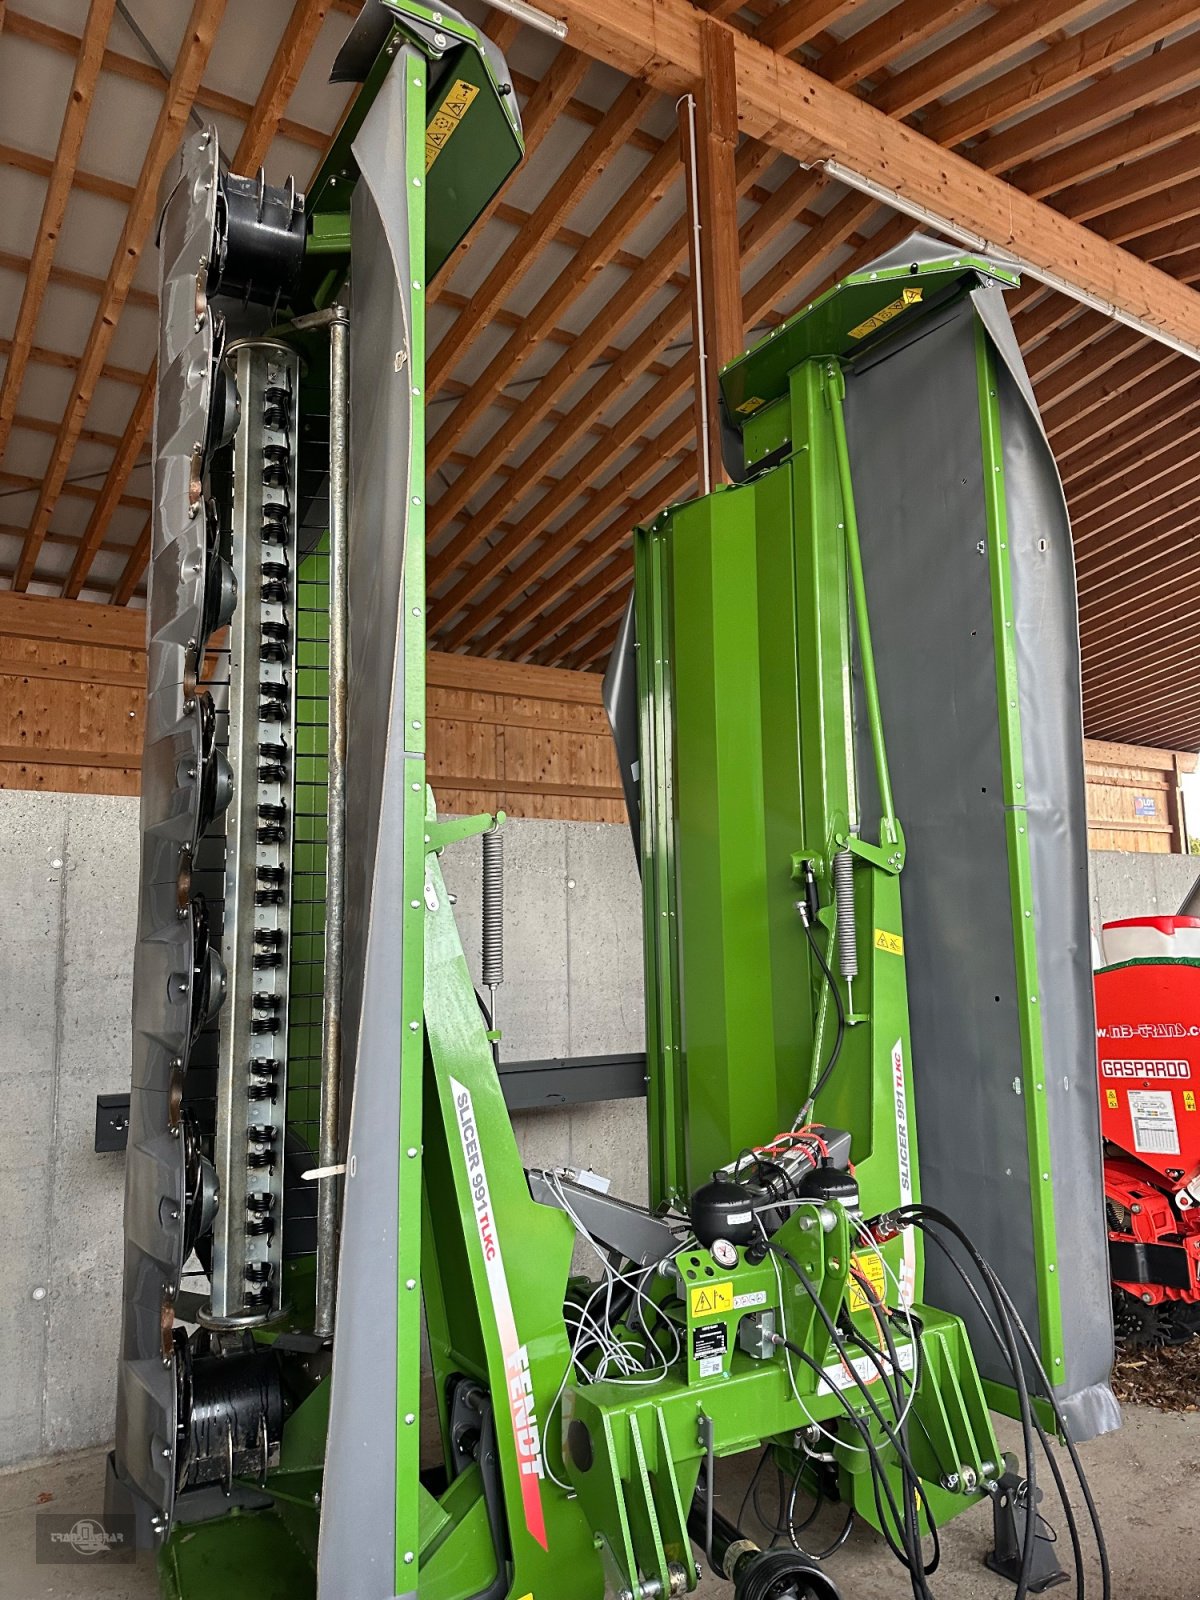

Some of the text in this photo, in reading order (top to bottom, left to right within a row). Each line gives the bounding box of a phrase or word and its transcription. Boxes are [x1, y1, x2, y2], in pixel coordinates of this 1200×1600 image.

[895, 1052, 909, 1191] SLICER 991 TLKC
[1102, 1061, 1189, 1078] GASPARDO
[457, 1092, 496, 1262] SLICER 991 TLKC
[506, 1344, 546, 1480] FENDT
